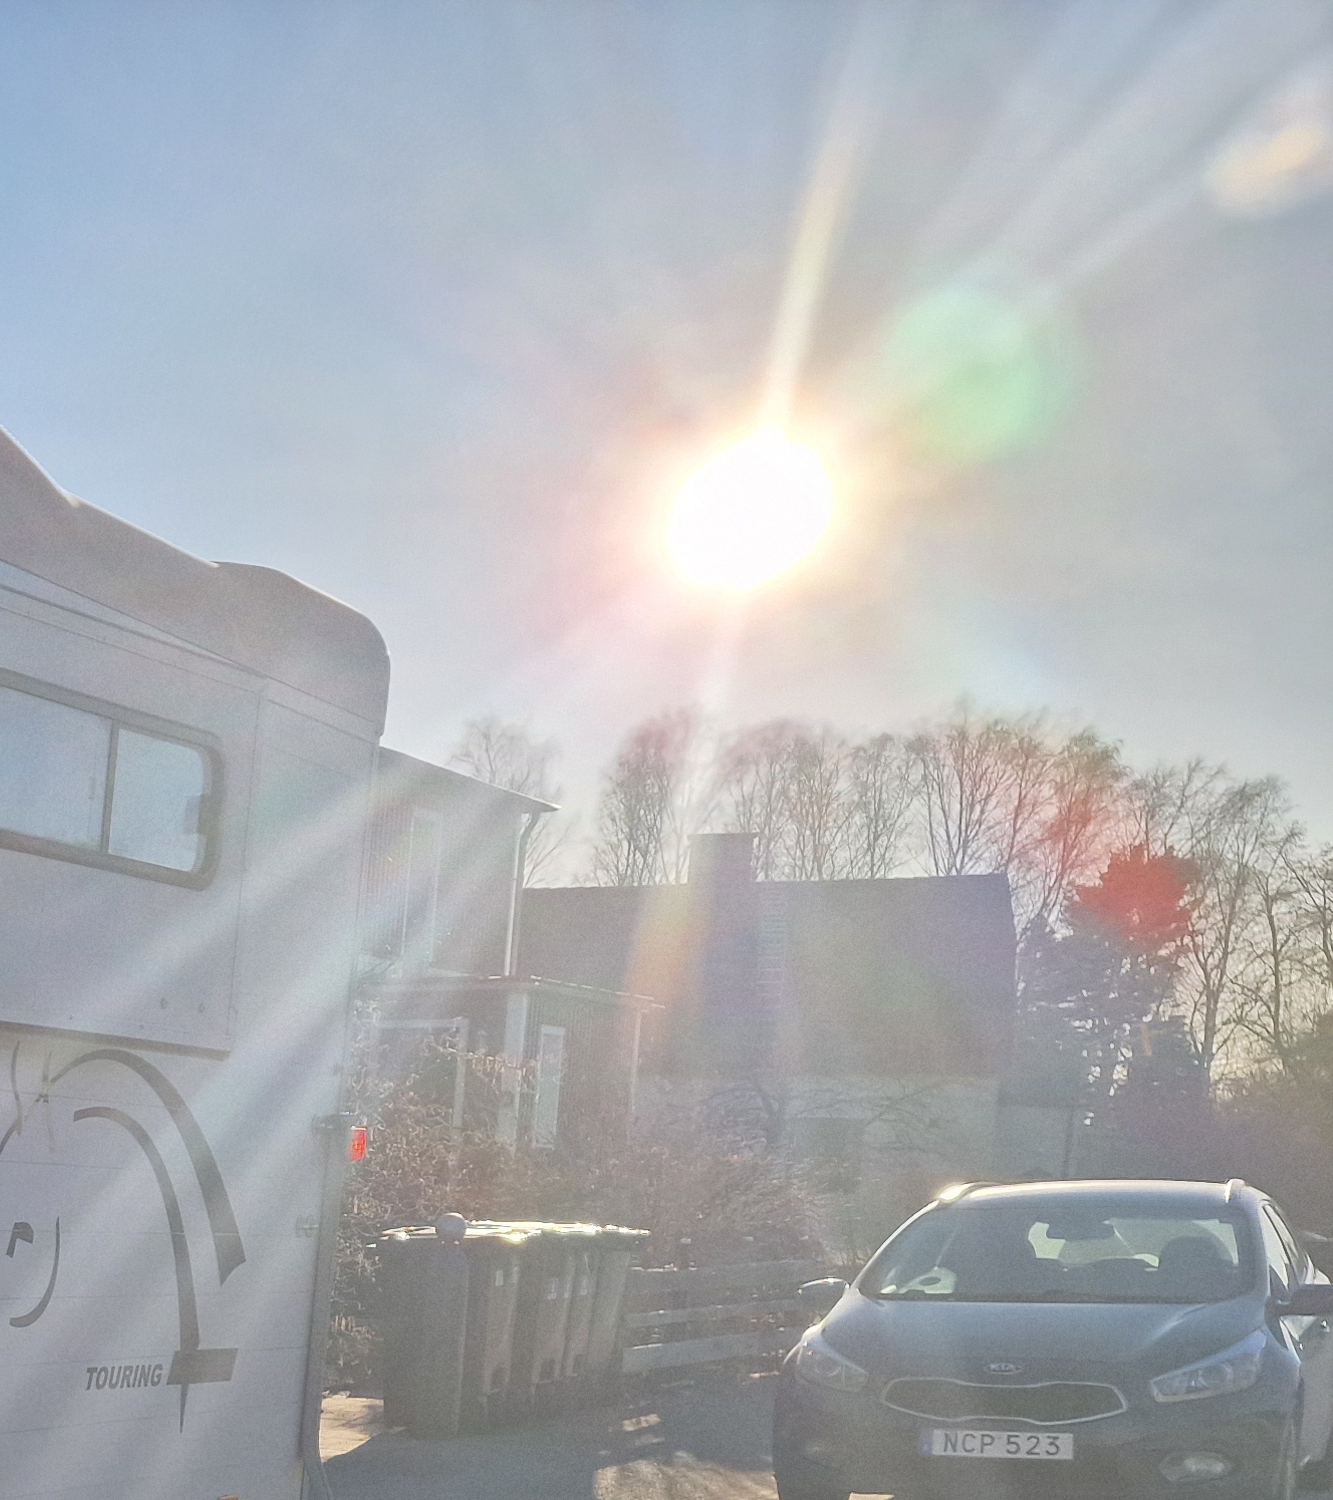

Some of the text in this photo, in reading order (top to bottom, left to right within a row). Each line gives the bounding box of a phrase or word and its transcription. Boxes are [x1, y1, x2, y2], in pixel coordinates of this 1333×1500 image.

[85, 1363, 164, 1390] TOURING
[943, 1432, 1061, 1456] NCP 523
